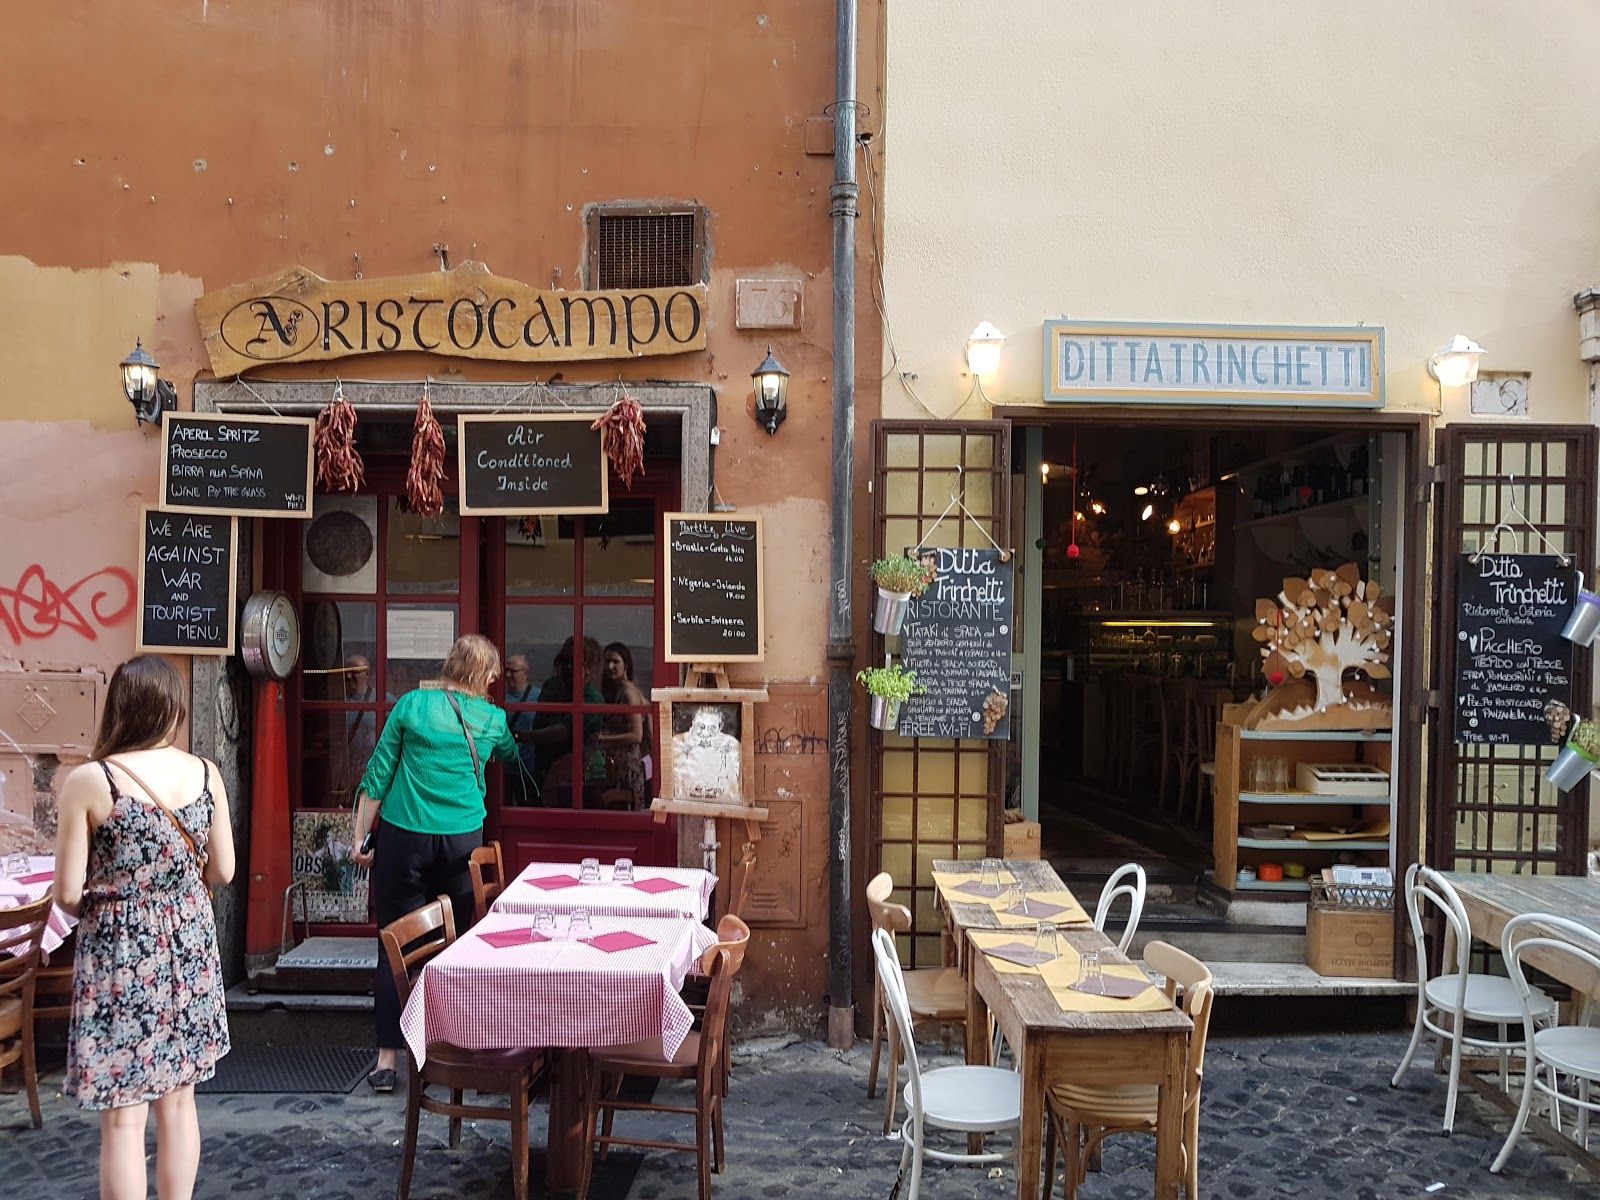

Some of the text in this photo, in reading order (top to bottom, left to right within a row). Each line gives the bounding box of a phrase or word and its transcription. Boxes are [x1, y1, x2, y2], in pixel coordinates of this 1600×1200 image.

[752, 288, 787, 319] 75
[217, 425, 260, 443] SPRITZ
[507, 424, 545, 446] Air
[170, 443, 228, 459] PROSECCO
[477, 450, 573, 470] Conditioned
[172, 464, 204, 478] BIRRA
[229, 464, 264, 480] SPINA
[170, 482, 200, 498] WINE
[223, 485, 239, 497] THE
[241, 486, 266, 498] GLASS
[496, 475, 550, 492] Inside
[149, 517, 212, 539] WE ARE
[146, 545, 225, 565] AGAINST
[936, 547, 996, 574] Ditta
[1479, 555, 1523, 578] Ditta
[161, 567, 202, 590] WAR
[170, 592, 189, 602] AND
[933, 575, 1006, 603] Trinchetti
[1490, 578, 1568, 605] Trinchetti
[145, 604, 217, 623] TOURIST
[907, 600, 1004, 621] RISTORANTE
[1463, 602, 1510, 617] Ristorante
[1518, 605, 1557, 618] Osteria
[1480, 627, 1543, 655] PACCHERO
[901, 720, 936, 737] FREE
